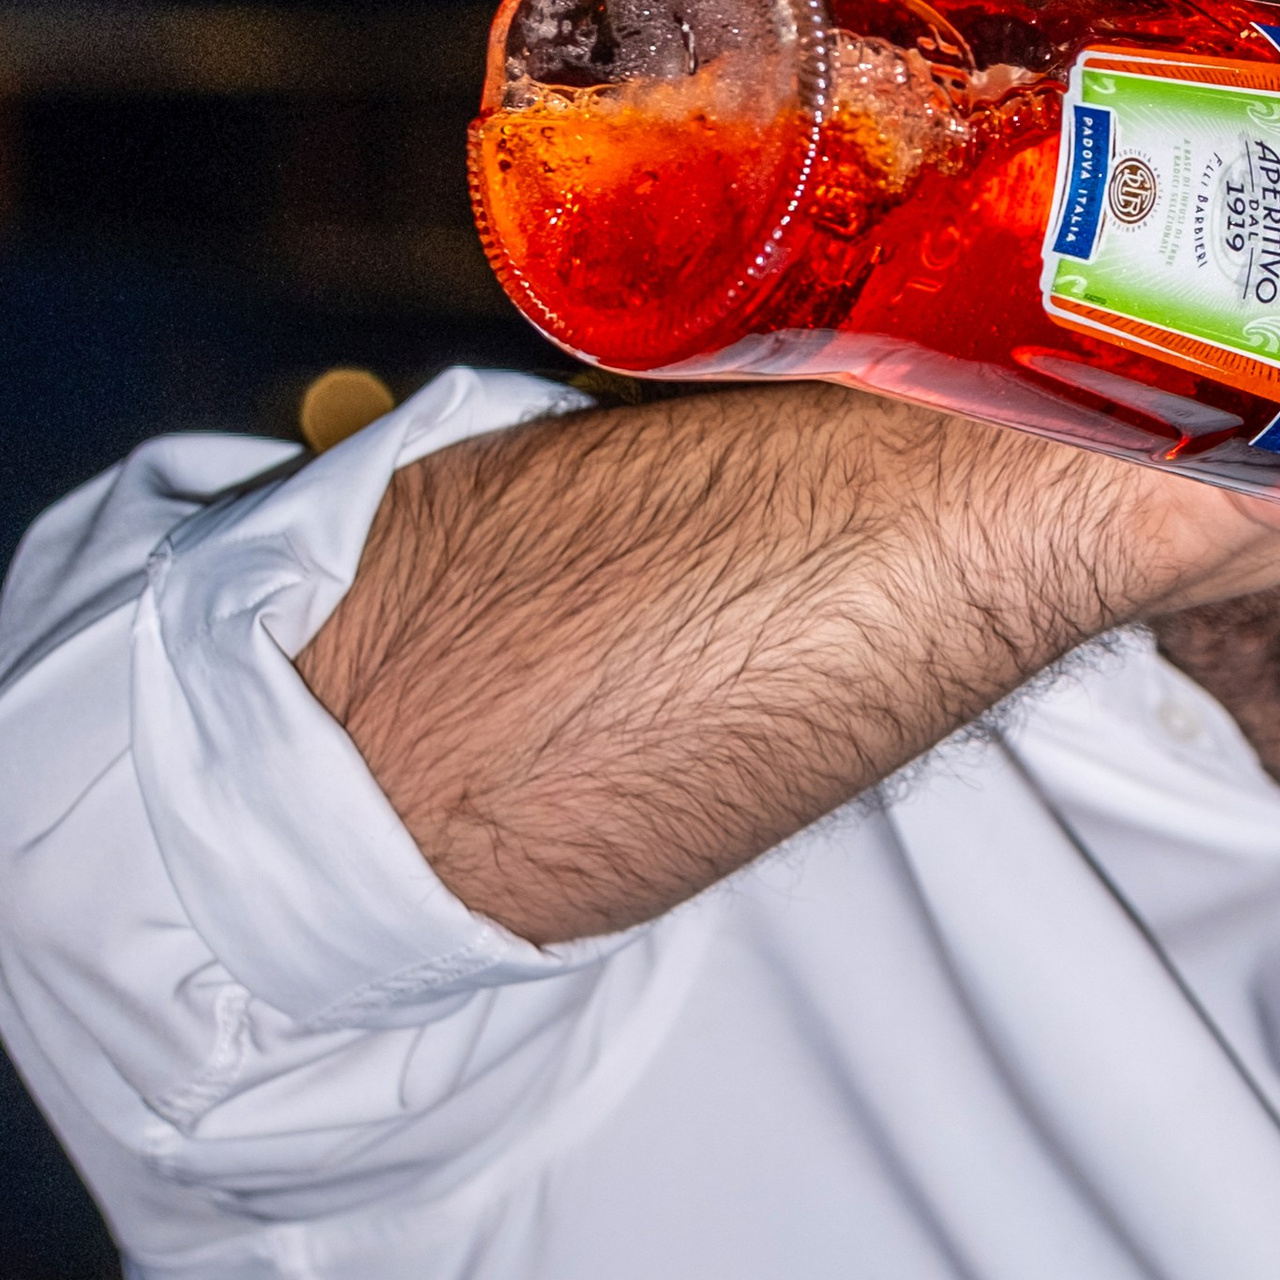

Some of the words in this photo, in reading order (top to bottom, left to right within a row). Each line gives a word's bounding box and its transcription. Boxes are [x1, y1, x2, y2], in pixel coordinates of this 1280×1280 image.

[1080, 116, 1094, 180] PADOVA
[1065, 189, 1089, 242] ITALIA
[1193, 194, 1209, 268] BARBIERI
[1225, 180, 1246, 253] 1919
[1248, 198, 1260, 242] DAL
